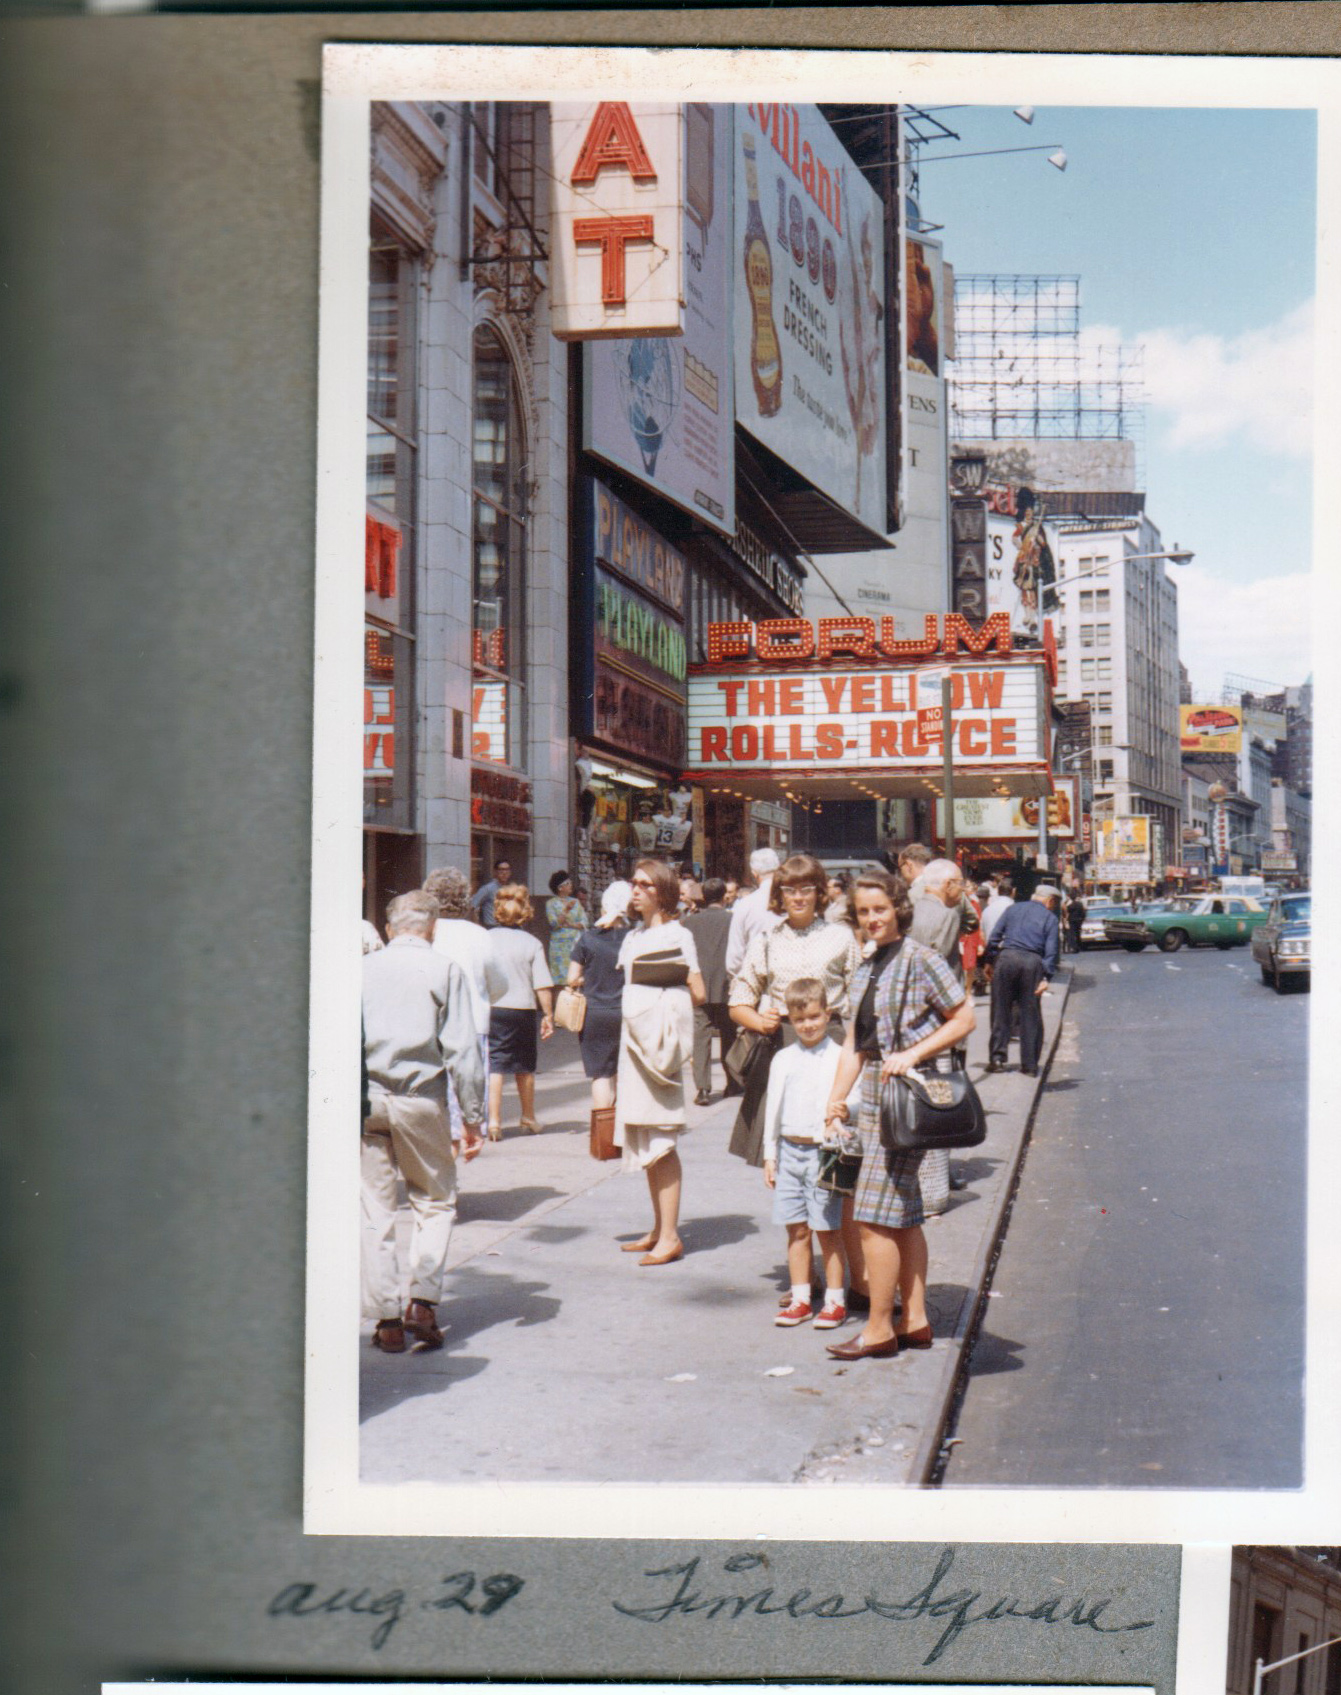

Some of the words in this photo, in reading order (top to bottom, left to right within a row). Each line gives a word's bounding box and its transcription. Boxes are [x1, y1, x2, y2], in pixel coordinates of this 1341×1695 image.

[777, 177, 836, 305] 1890
[784, 303, 833, 376] DRESSING
[789, 277, 828, 341] FRENCH
[599, 494, 684, 609] PLAYLAND
[600, 583, 687, 674] PLAYLAND
[708, 612, 1011, 663] FORUM
[718, 679, 804, 717] THE
[926, 708, 941, 721] NO
[656, 829, 674, 844] 13
[612, 1550, 868, 1624] Times
[866, 1547, 1155, 1667] Square
